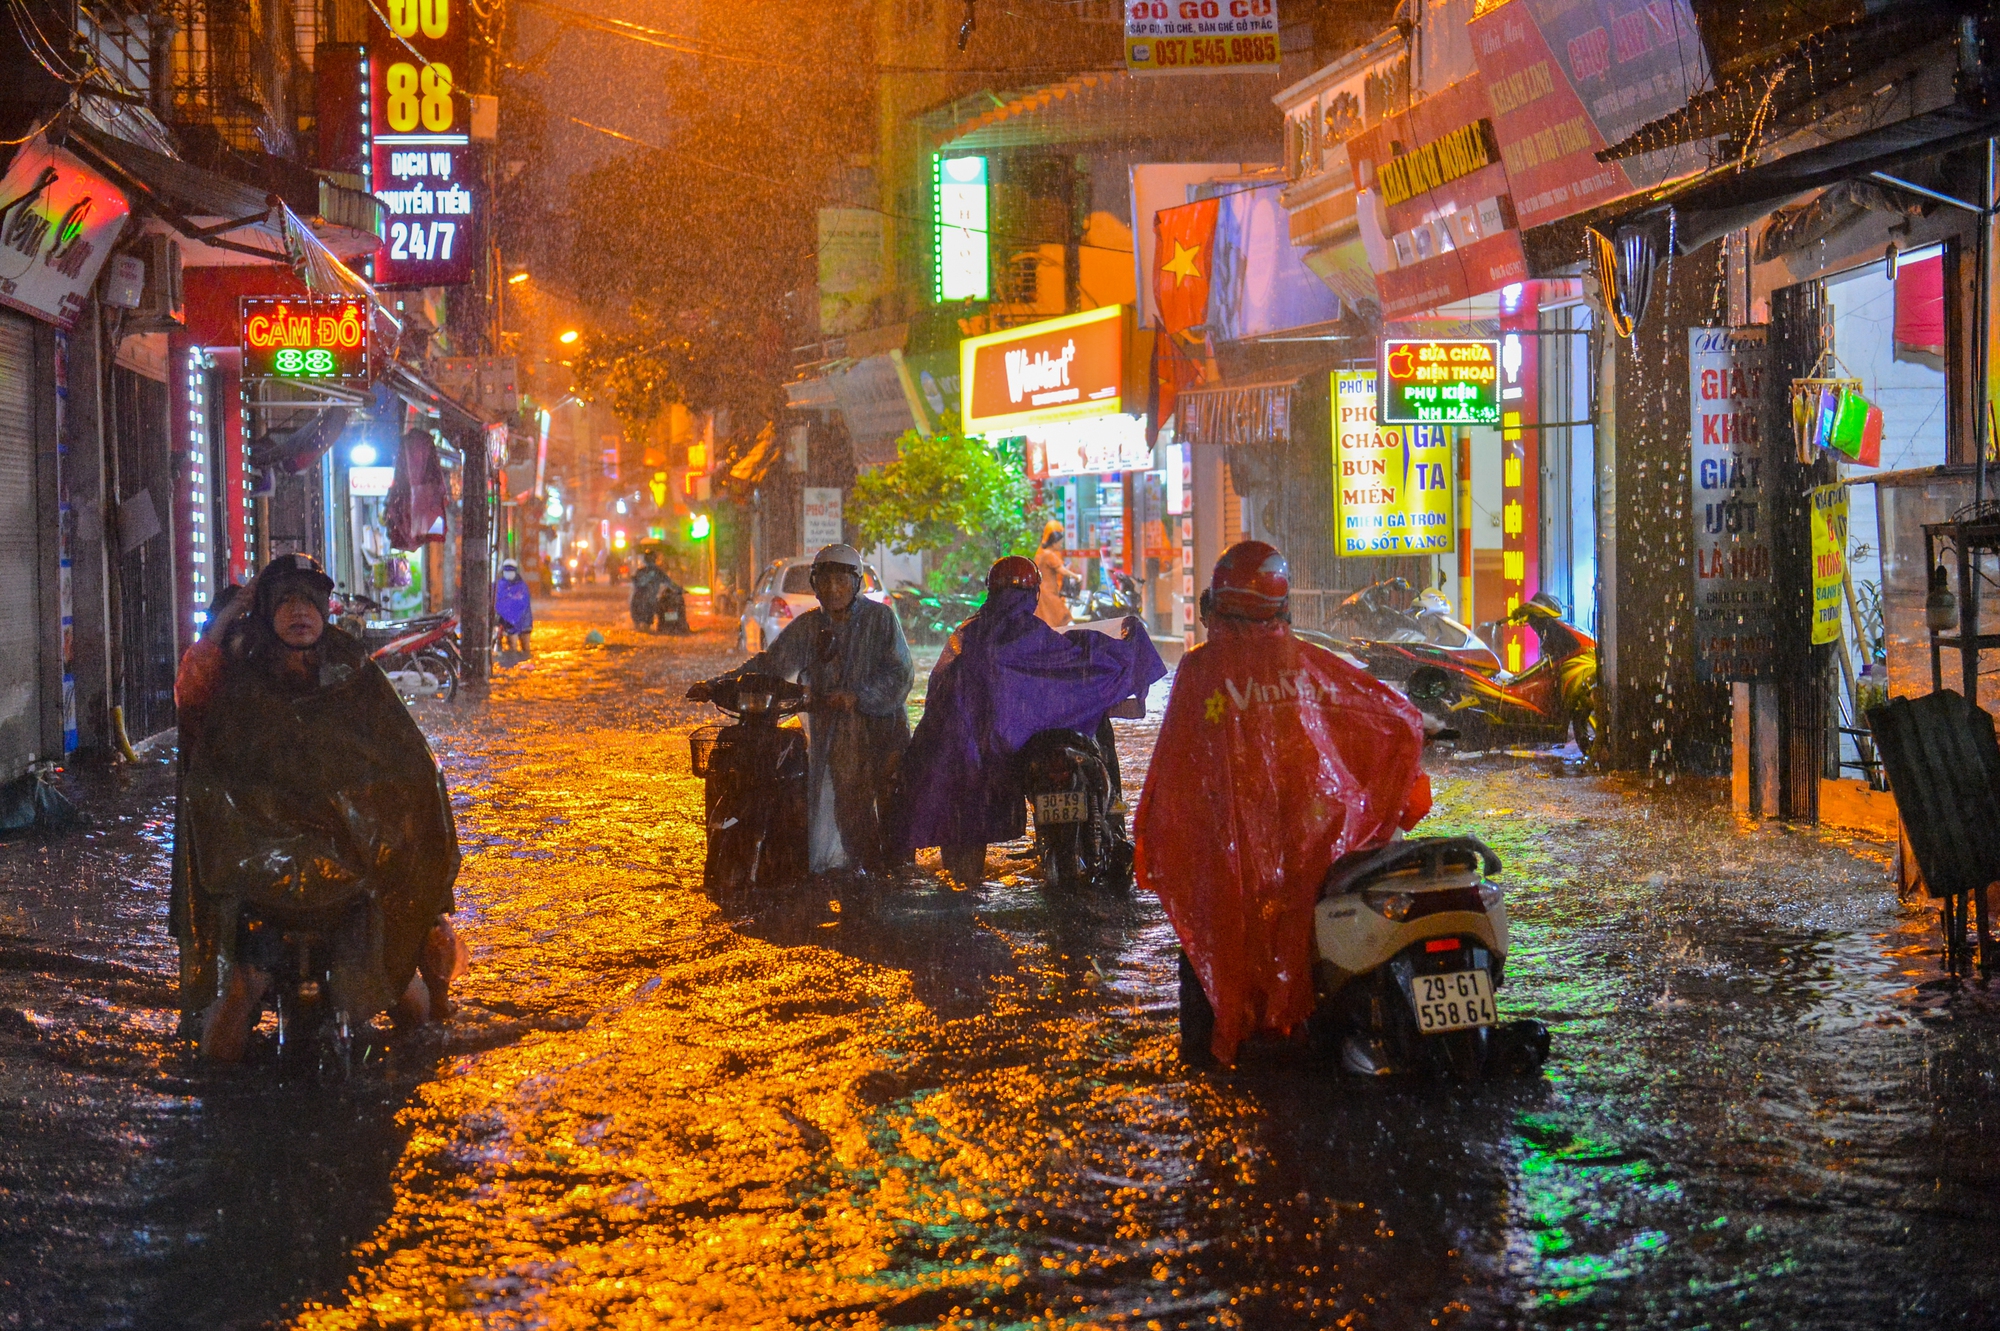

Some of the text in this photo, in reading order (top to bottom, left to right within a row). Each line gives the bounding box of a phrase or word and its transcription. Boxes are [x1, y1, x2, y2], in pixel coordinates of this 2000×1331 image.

[1155, 36, 1276, 66] 037.545.9885
[1525, 58, 1554, 101] LINH
[386, 62, 454, 132] 88
[1554, 114, 1592, 157] TRANG
[391, 152, 451, 181] DỊCH VỤ
[1404, 141, 1443, 197] MINH
[1435, 119, 1489, 183] MOBILE
[390, 221, 455, 261] 24/7
[276, 349, 333, 372] 88
[1418, 342, 1492, 361] SỬA CHỮA
[1416, 362, 1495, 384] ĐIỆN THOẠI
[1701, 361, 1763, 407] GIẶT
[1404, 381, 1477, 403] PHỤ KIỆN
[1341, 428, 1400, 449] CHÁO
[1702, 407, 1759, 445] KHÔ
[1415, 463, 1446, 490] TA
[1700, 452, 1763, 497] GIẶT
[1387, 511, 1406, 527] GÀ
[1410, 510, 1447, 529] TRỘN
[1371, 531, 1399, 550] SỐT
[1404, 535, 1447, 550] VANG
[1698, 541, 1725, 579] LÀ
[1423, 973, 1479, 1001] 29-G1
[1421, 998, 1491, 1028] 558.64
